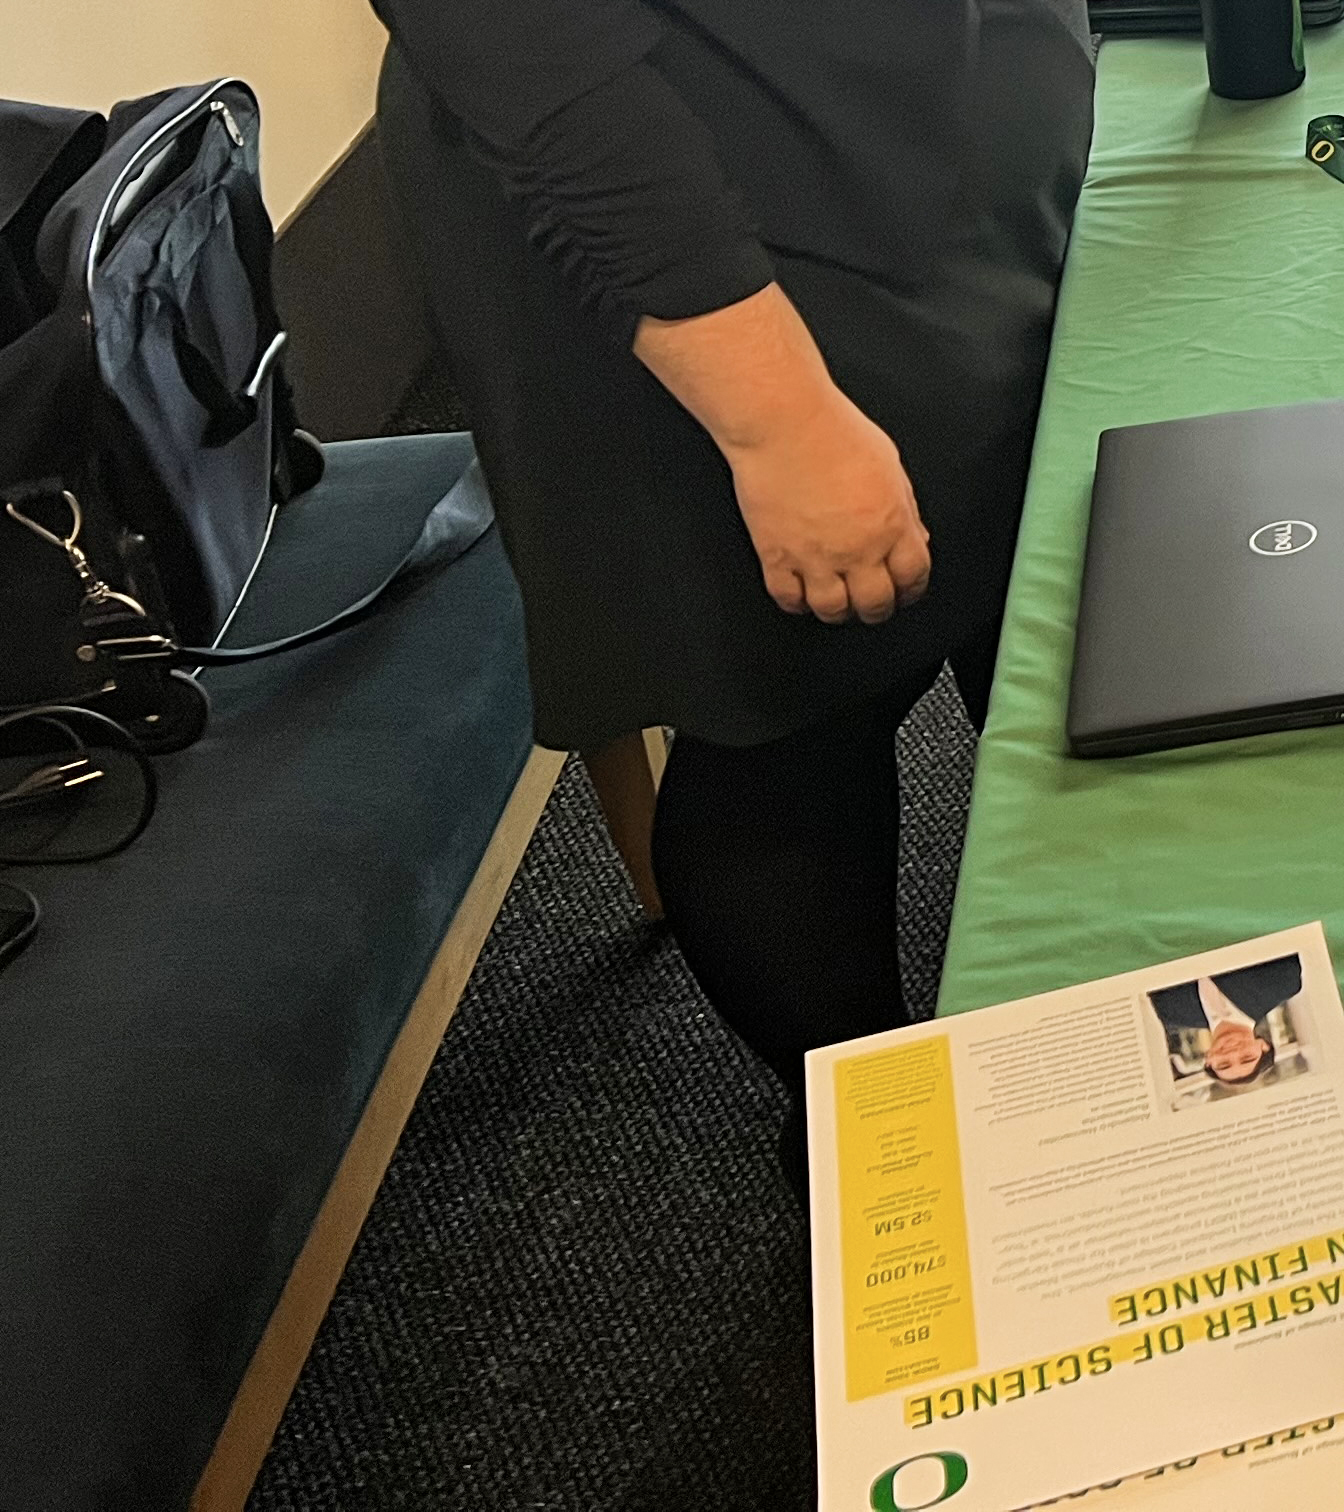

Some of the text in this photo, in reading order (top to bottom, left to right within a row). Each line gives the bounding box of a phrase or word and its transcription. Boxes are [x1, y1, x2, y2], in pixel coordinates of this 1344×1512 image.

[1273, 523, 1293, 552] DELL
[872, 1209, 934, 1239] $2.5M
[863, 1252, 947, 1289] $74,000
[1112, 1248, 1312, 1326] FINANCE
[889, 1323, 932, 1348] 85%
[1132, 1326, 1186, 1358] OF
[908, 1342, 1115, 1429] SCIENCE
